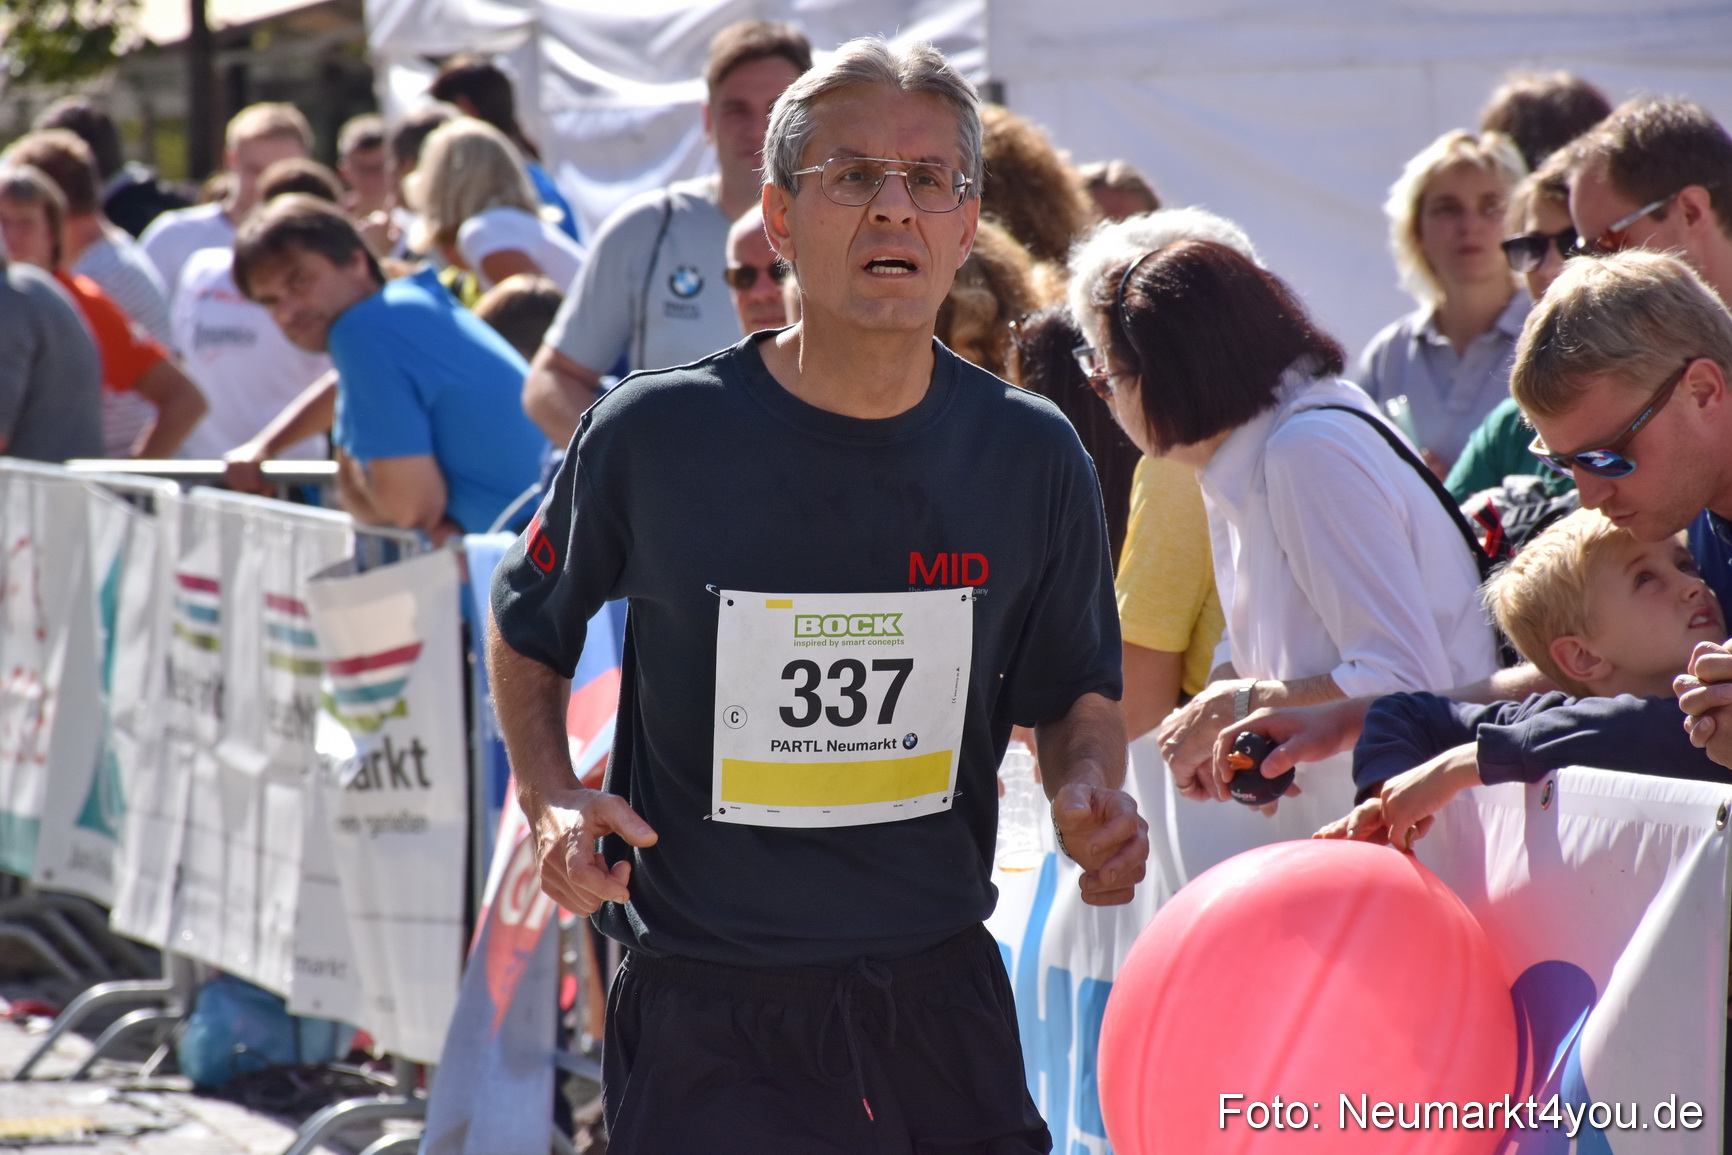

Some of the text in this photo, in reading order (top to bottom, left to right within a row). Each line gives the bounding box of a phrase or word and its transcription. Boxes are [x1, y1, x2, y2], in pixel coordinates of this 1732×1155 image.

[908, 551, 989, 586] MID
[794, 613, 904, 638] BOCK
[793, 639, 827, 648] inspired
[829, 639, 839, 648] by
[867, 638, 905, 647] concepts
[778, 658, 914, 728] 337
[730, 711, 739, 724] C
[770, 738, 897, 752] PARTL Neumarkt
[345, 736, 432, 791] arkt
